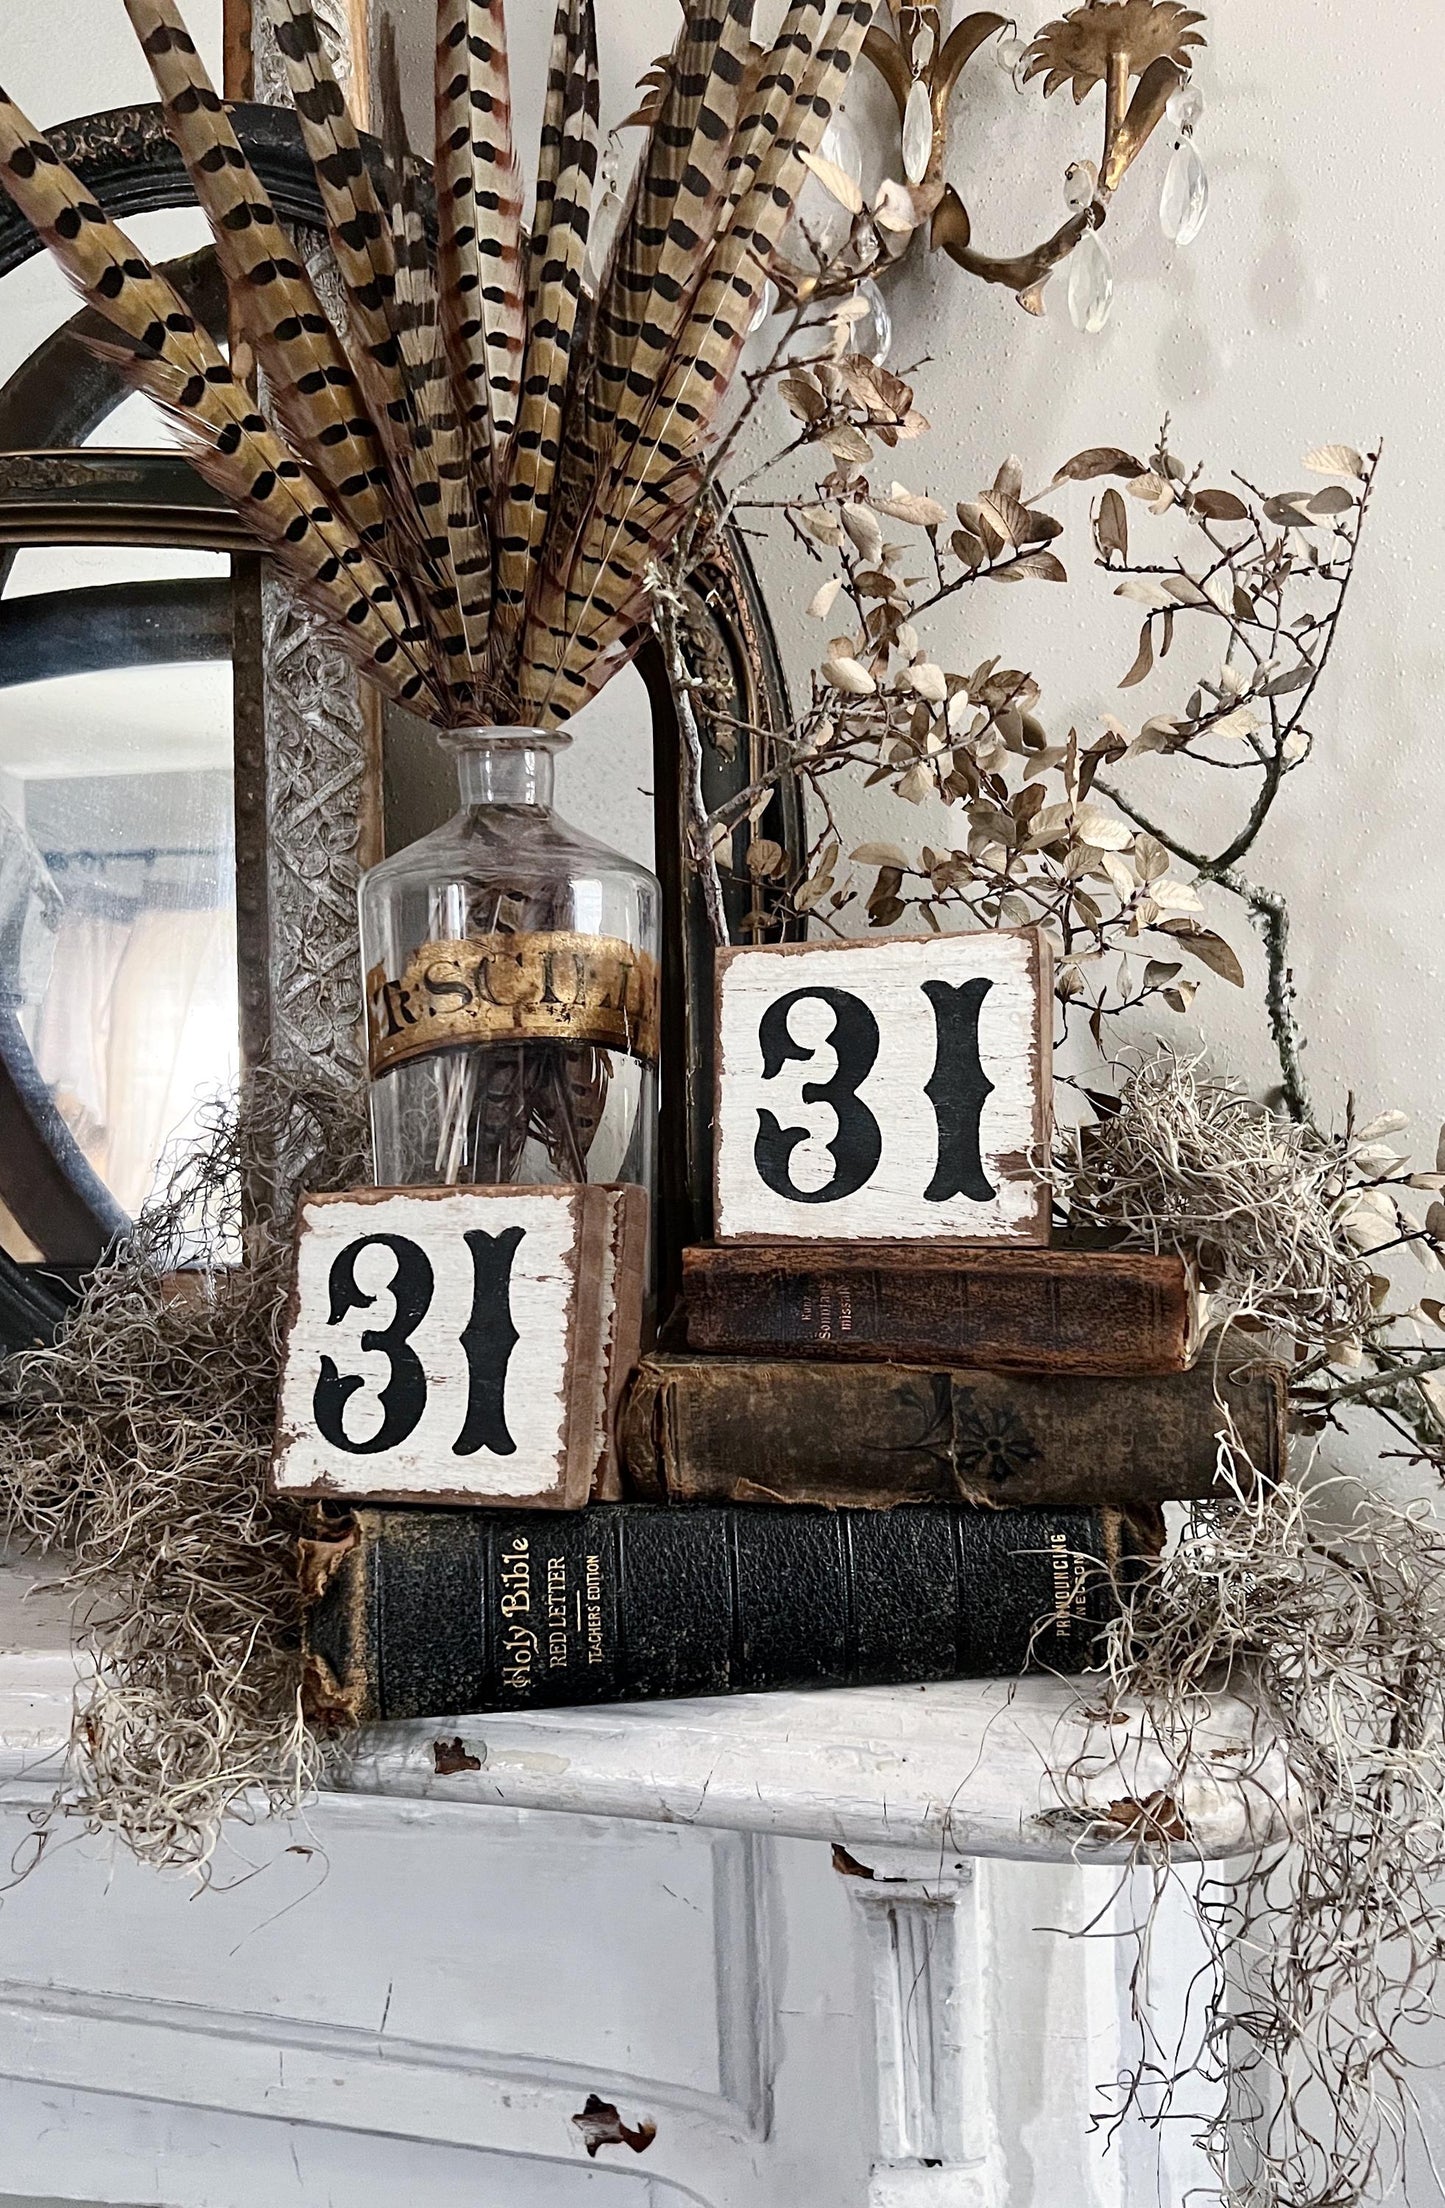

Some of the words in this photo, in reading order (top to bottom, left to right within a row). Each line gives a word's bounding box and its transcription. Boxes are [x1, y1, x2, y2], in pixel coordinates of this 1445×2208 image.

[754, 977, 997, 1203] 31
[313, 1226, 527, 1456] 31
[501, 1537, 530, 1618] Bible
[547, 1556, 567, 1628] LETTER
[586, 1554, 601, 1601] EDITION
[502, 1625, 539, 1688] Holy
[549, 1631, 567, 1668] RED
